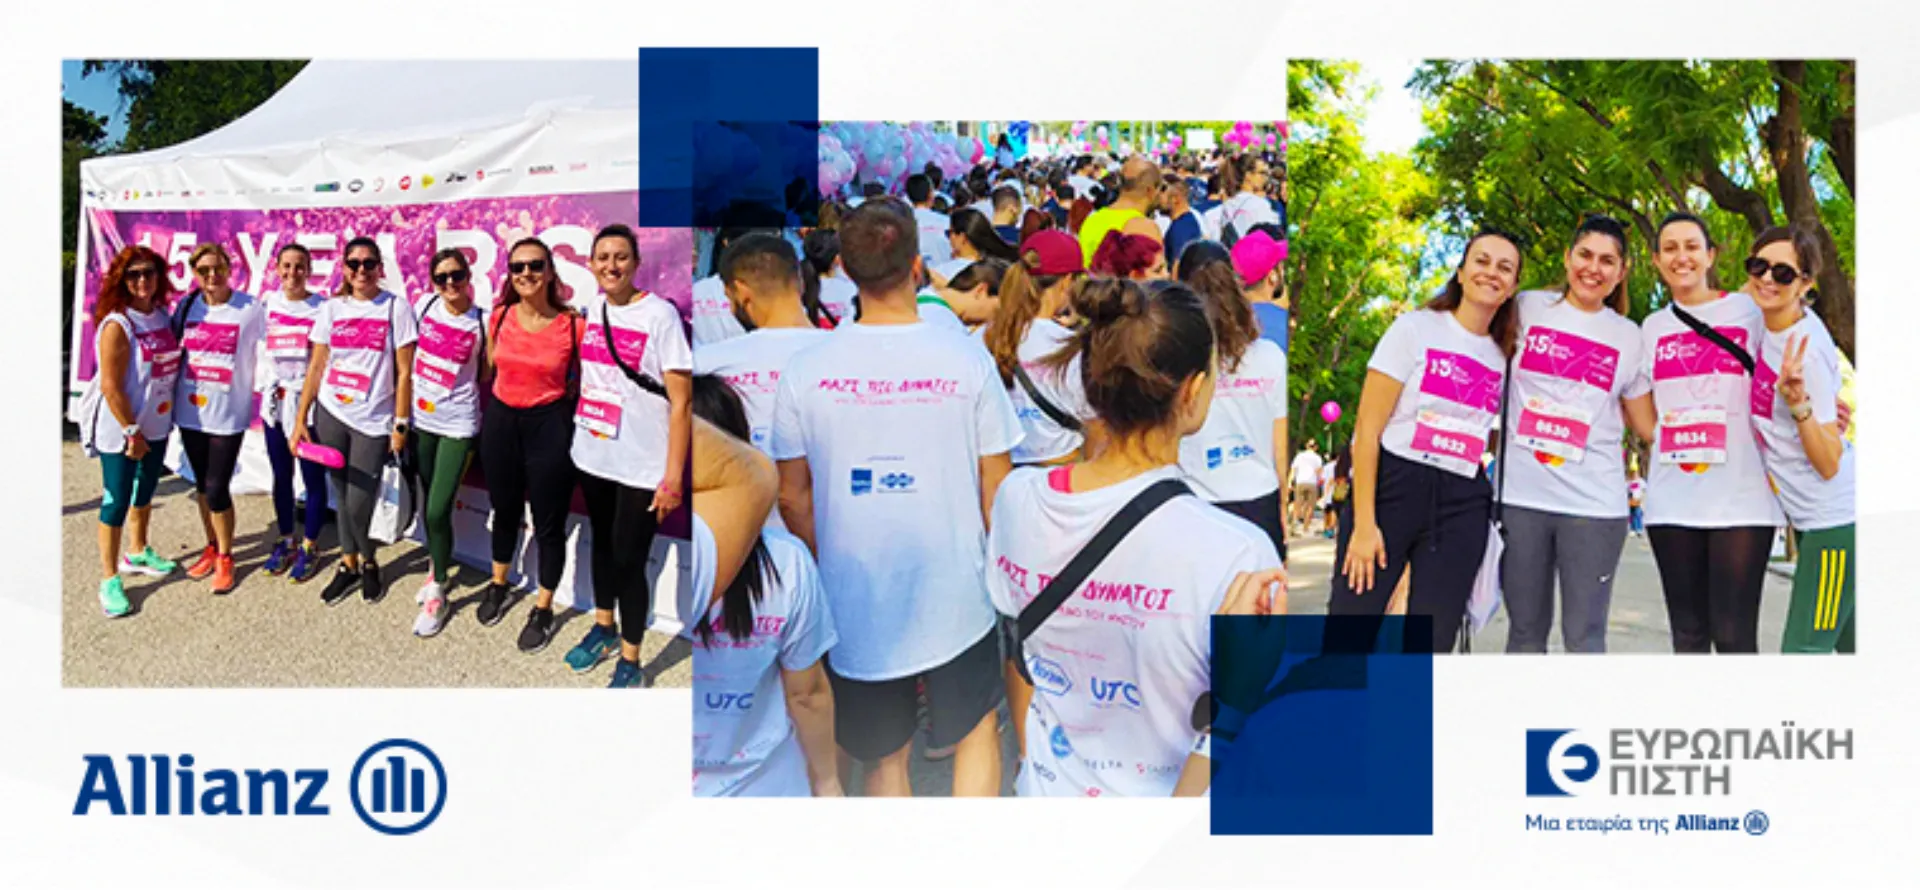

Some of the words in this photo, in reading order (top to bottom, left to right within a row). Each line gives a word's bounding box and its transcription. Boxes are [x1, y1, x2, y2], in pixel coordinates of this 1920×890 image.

[137, 232, 197, 291] 5
[1656, 341, 1677, 361] 15
[1673, 431, 1707, 444] 0634
[1081, 579, 1174, 611] ΔΥΝΑΤΟΙ
[706, 692, 754, 709] UTC
[1090, 676, 1141, 707] UTC
